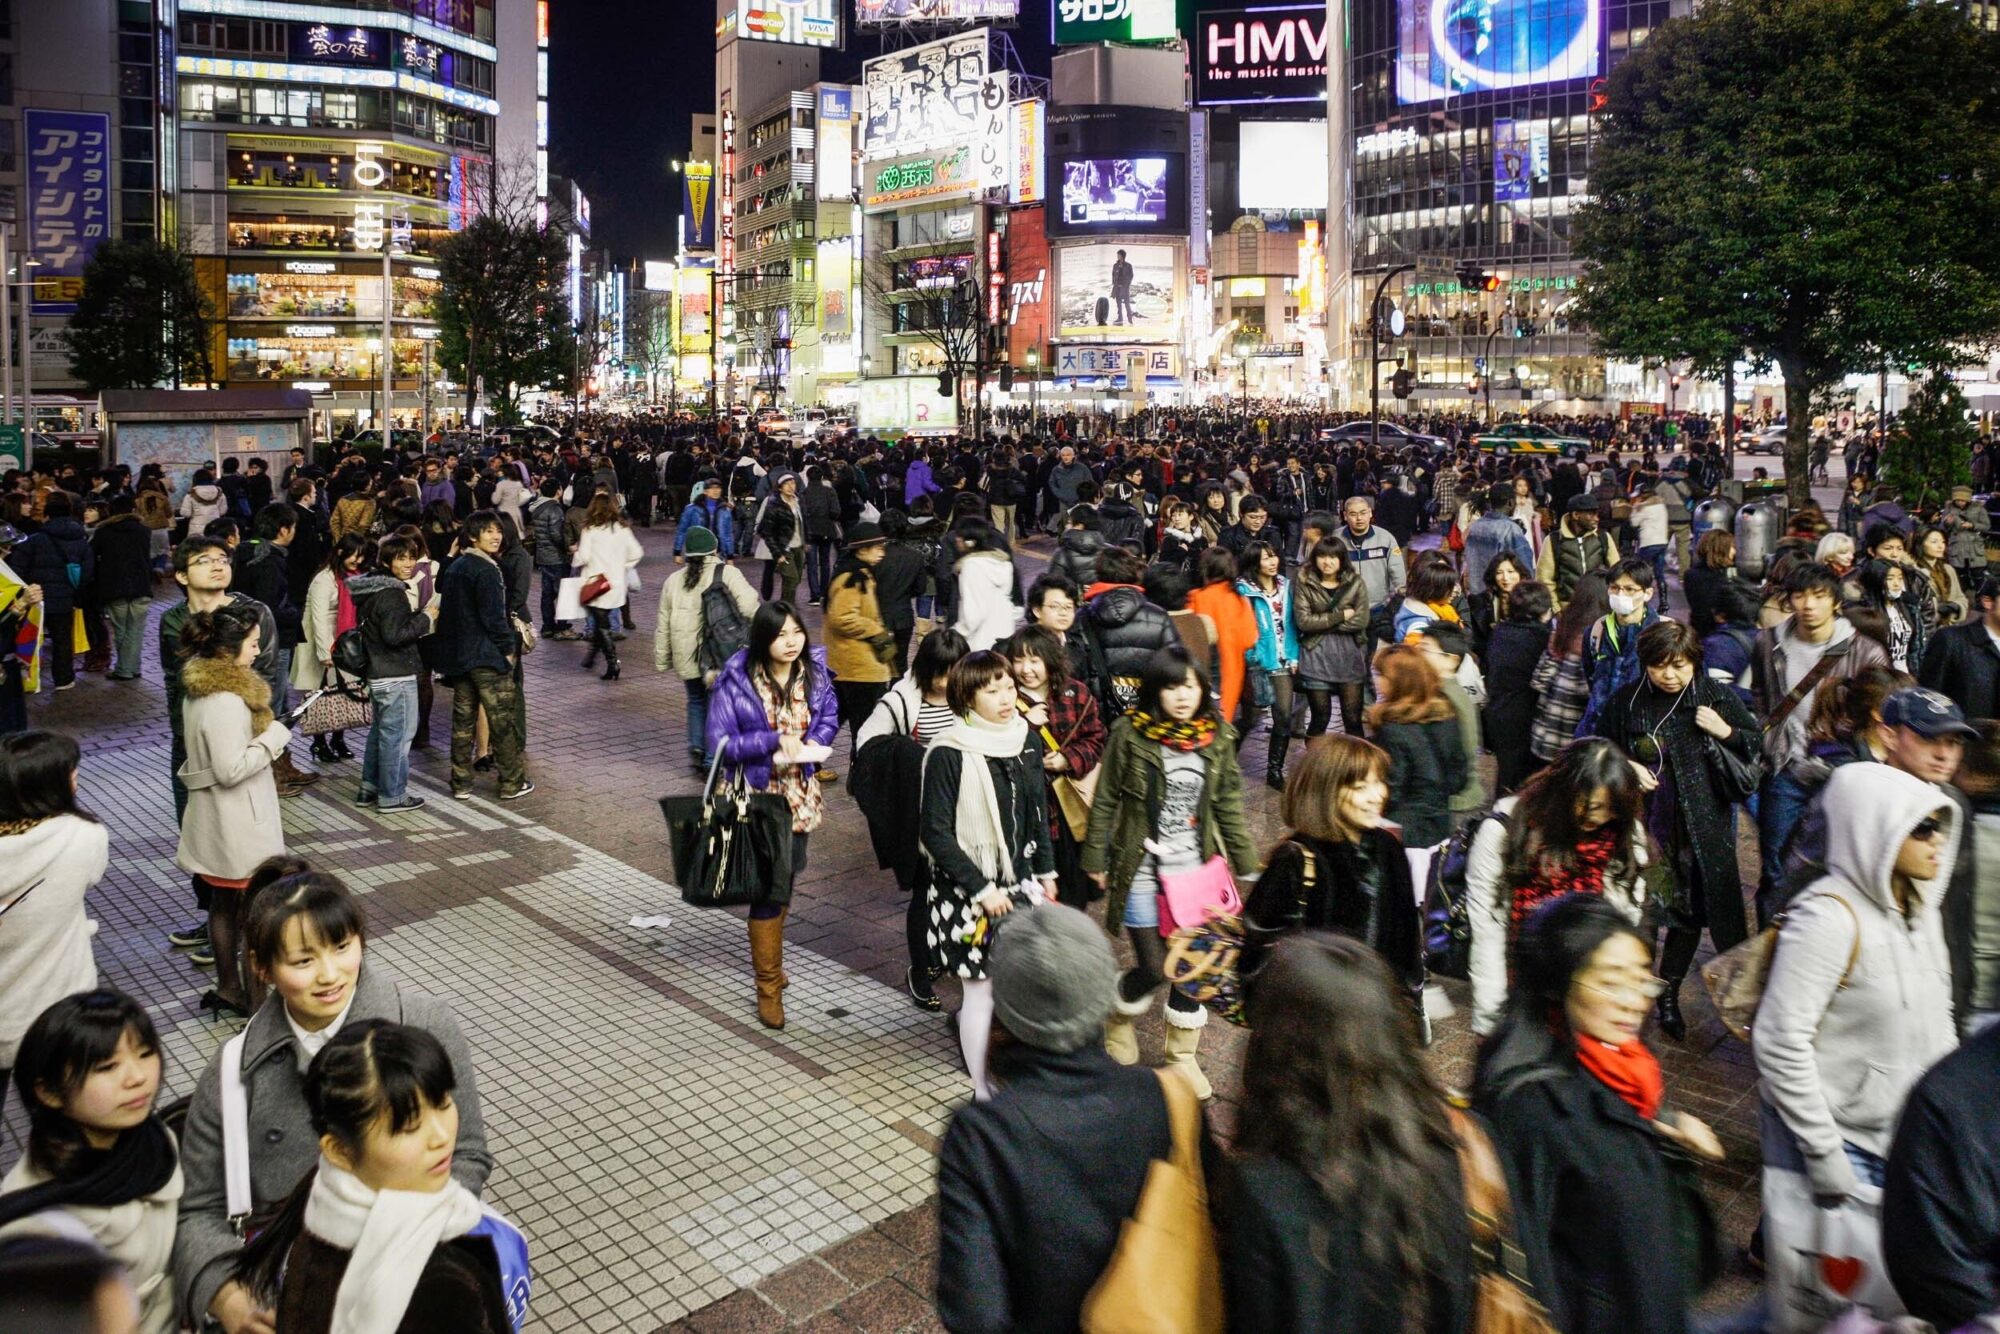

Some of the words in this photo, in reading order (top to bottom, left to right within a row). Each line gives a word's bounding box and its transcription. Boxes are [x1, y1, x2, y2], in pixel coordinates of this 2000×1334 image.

[960, 2, 979, 13] New
[984, 2, 1014, 13] Album
[1059, 0, 1132, 22] サロン
[808, 24, 829, 32] VISA
[1208, 18, 1328, 65] HMV
[1208, 67, 1232, 80] the
[1238, 65, 1278, 79] music
[1069, 113, 1091, 121] Vision
[261, 138, 297, 148] Natural
[1193, 133, 1202, 179] Taisei
[82, 131, 103, 237] コンタクトの
[901, 167, 934, 188] 西村
[32, 129, 79, 269] アイシティ
[1193, 185, 1201, 226] neon
[1010, 268, 1046, 325] クスリ
[1407, 281, 1480, 297] STARBU
